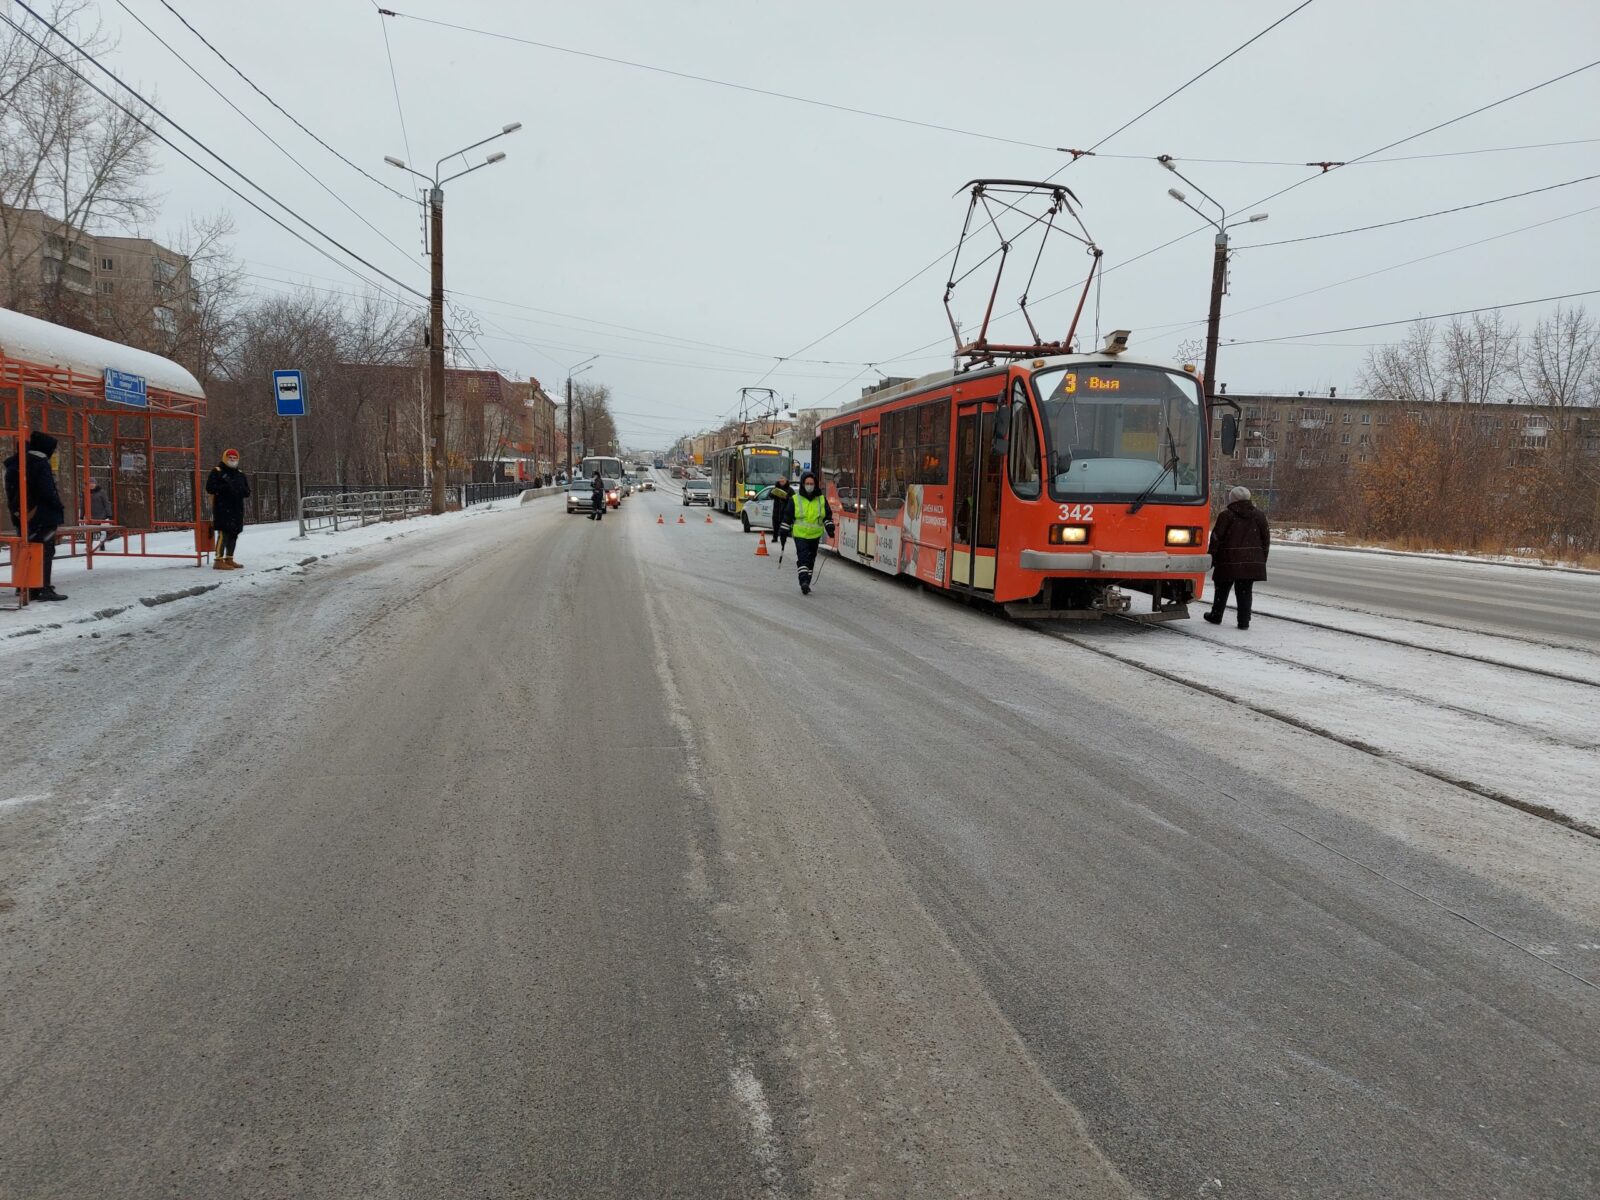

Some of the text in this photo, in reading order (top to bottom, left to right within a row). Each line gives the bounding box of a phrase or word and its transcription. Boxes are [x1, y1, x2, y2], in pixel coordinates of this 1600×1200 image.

[1064, 373, 1120, 393] 3 Выя
[1058, 503, 1094, 521] 342
